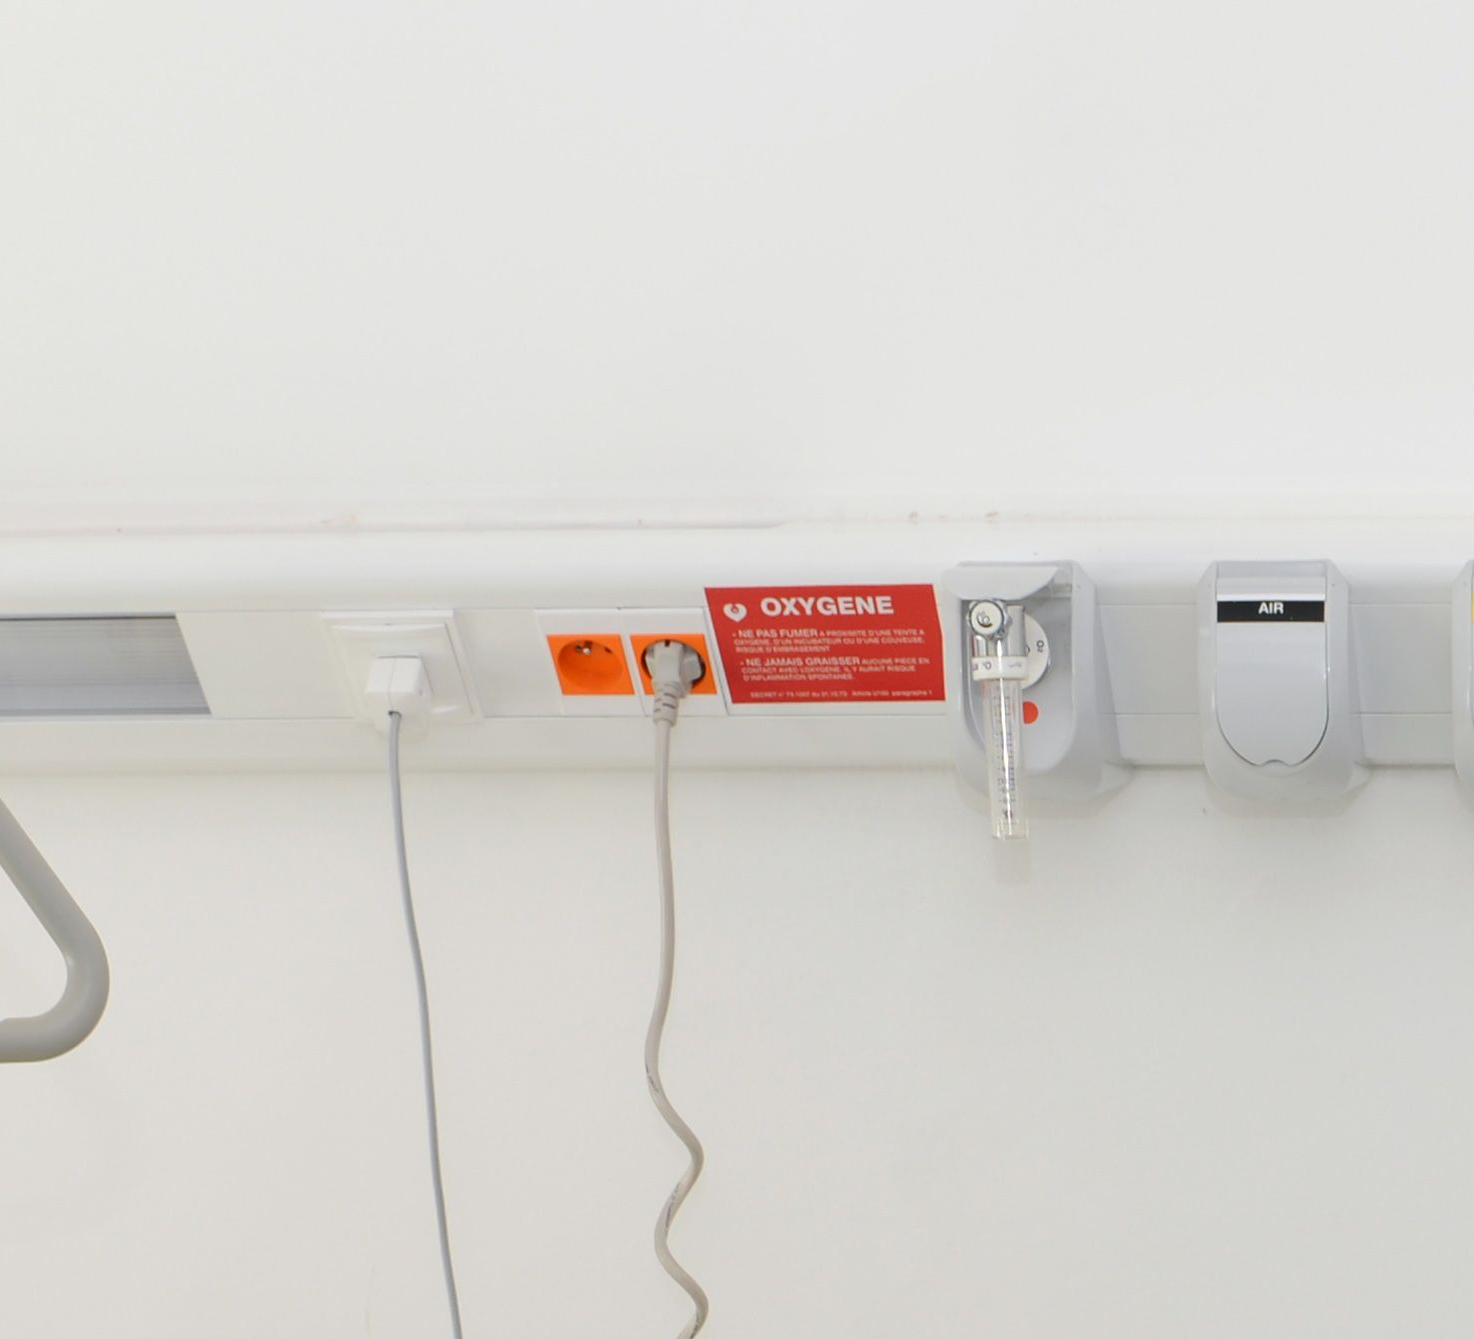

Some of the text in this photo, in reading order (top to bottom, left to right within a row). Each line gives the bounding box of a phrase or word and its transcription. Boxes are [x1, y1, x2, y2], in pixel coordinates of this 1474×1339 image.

[760, 595, 894, 617] OXYGENE
[1258, 602, 1284, 614] AIR
[738, 629, 754, 638] NE
[756, 628, 778, 638] PAS
[779, 628, 817, 638] FUMER
